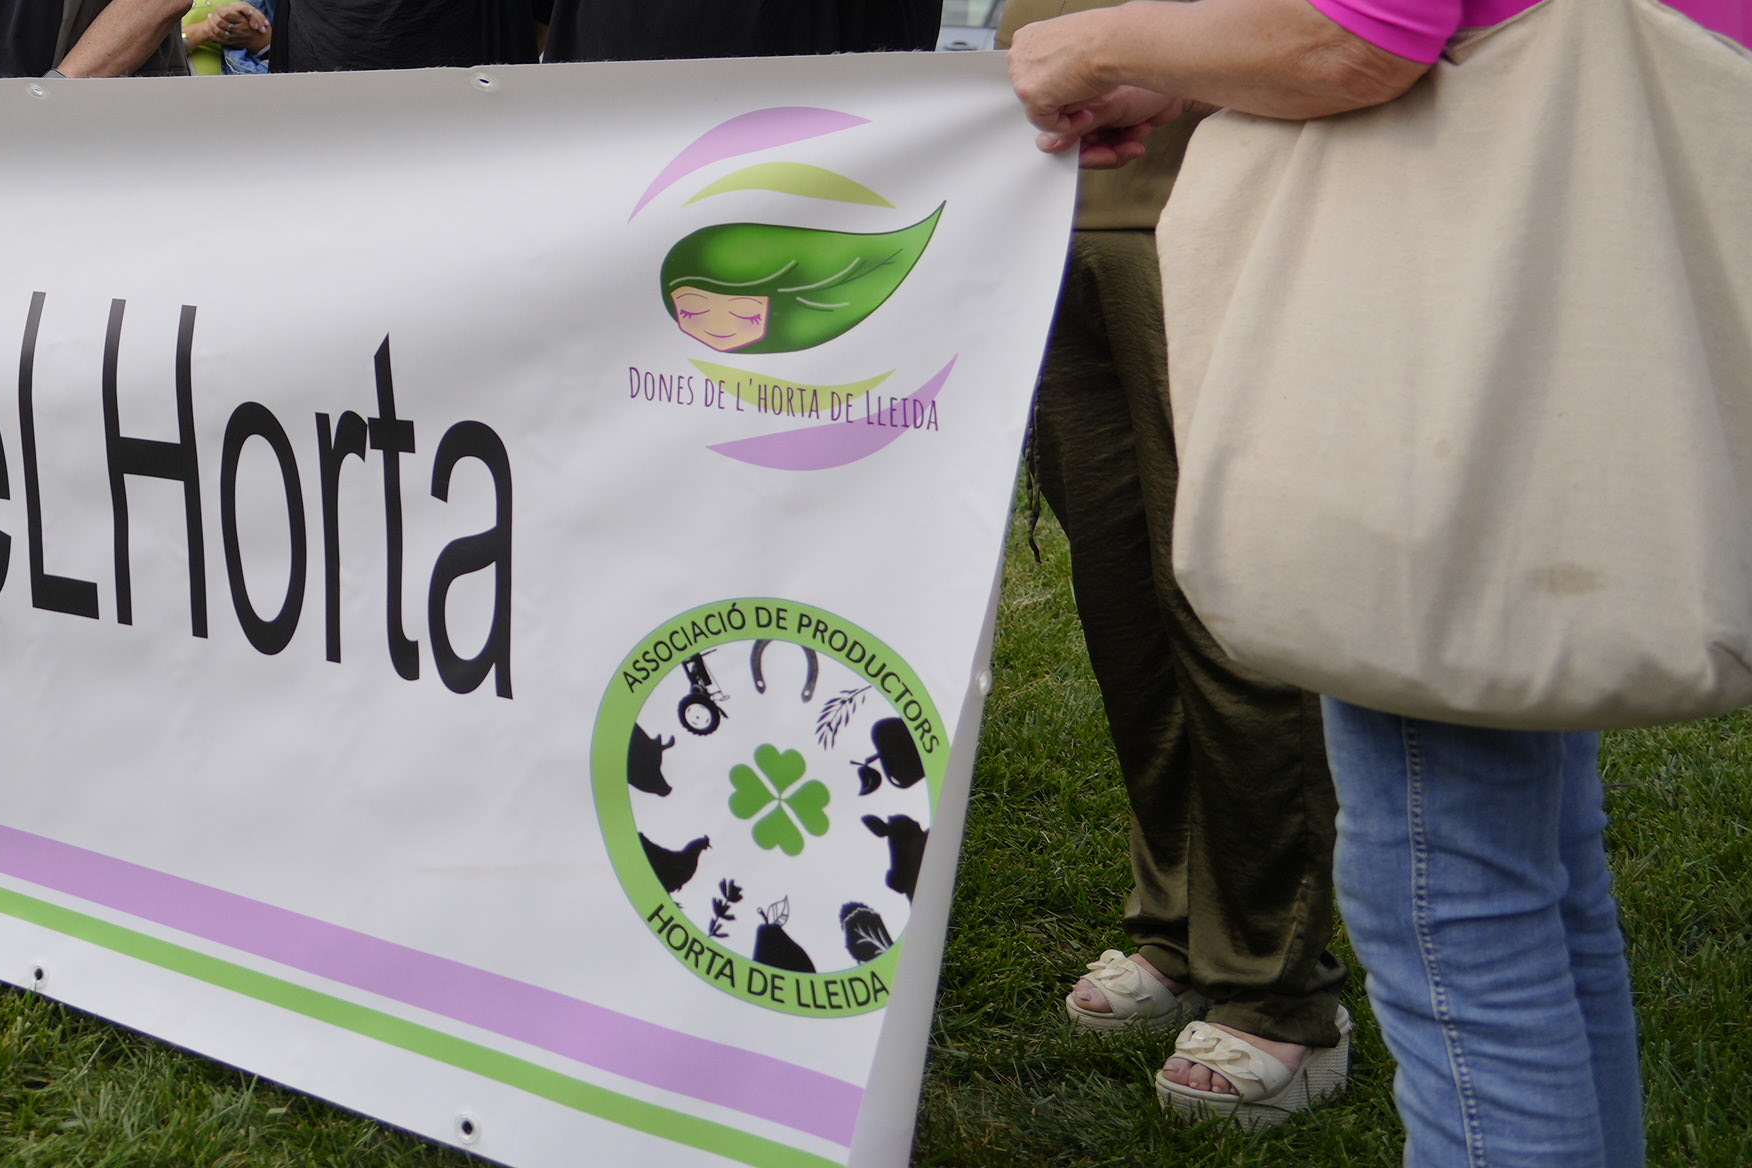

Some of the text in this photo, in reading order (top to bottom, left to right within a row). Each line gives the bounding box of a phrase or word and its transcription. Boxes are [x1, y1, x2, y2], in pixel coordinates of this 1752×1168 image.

[704, 378, 726, 410] DE
[831, 391, 854, 424] DE
[622, 602, 939, 755] ASSOCIACIÓ DE PRODUCTORS
[647, 903, 890, 1010] HORTA DE LLEIDA
